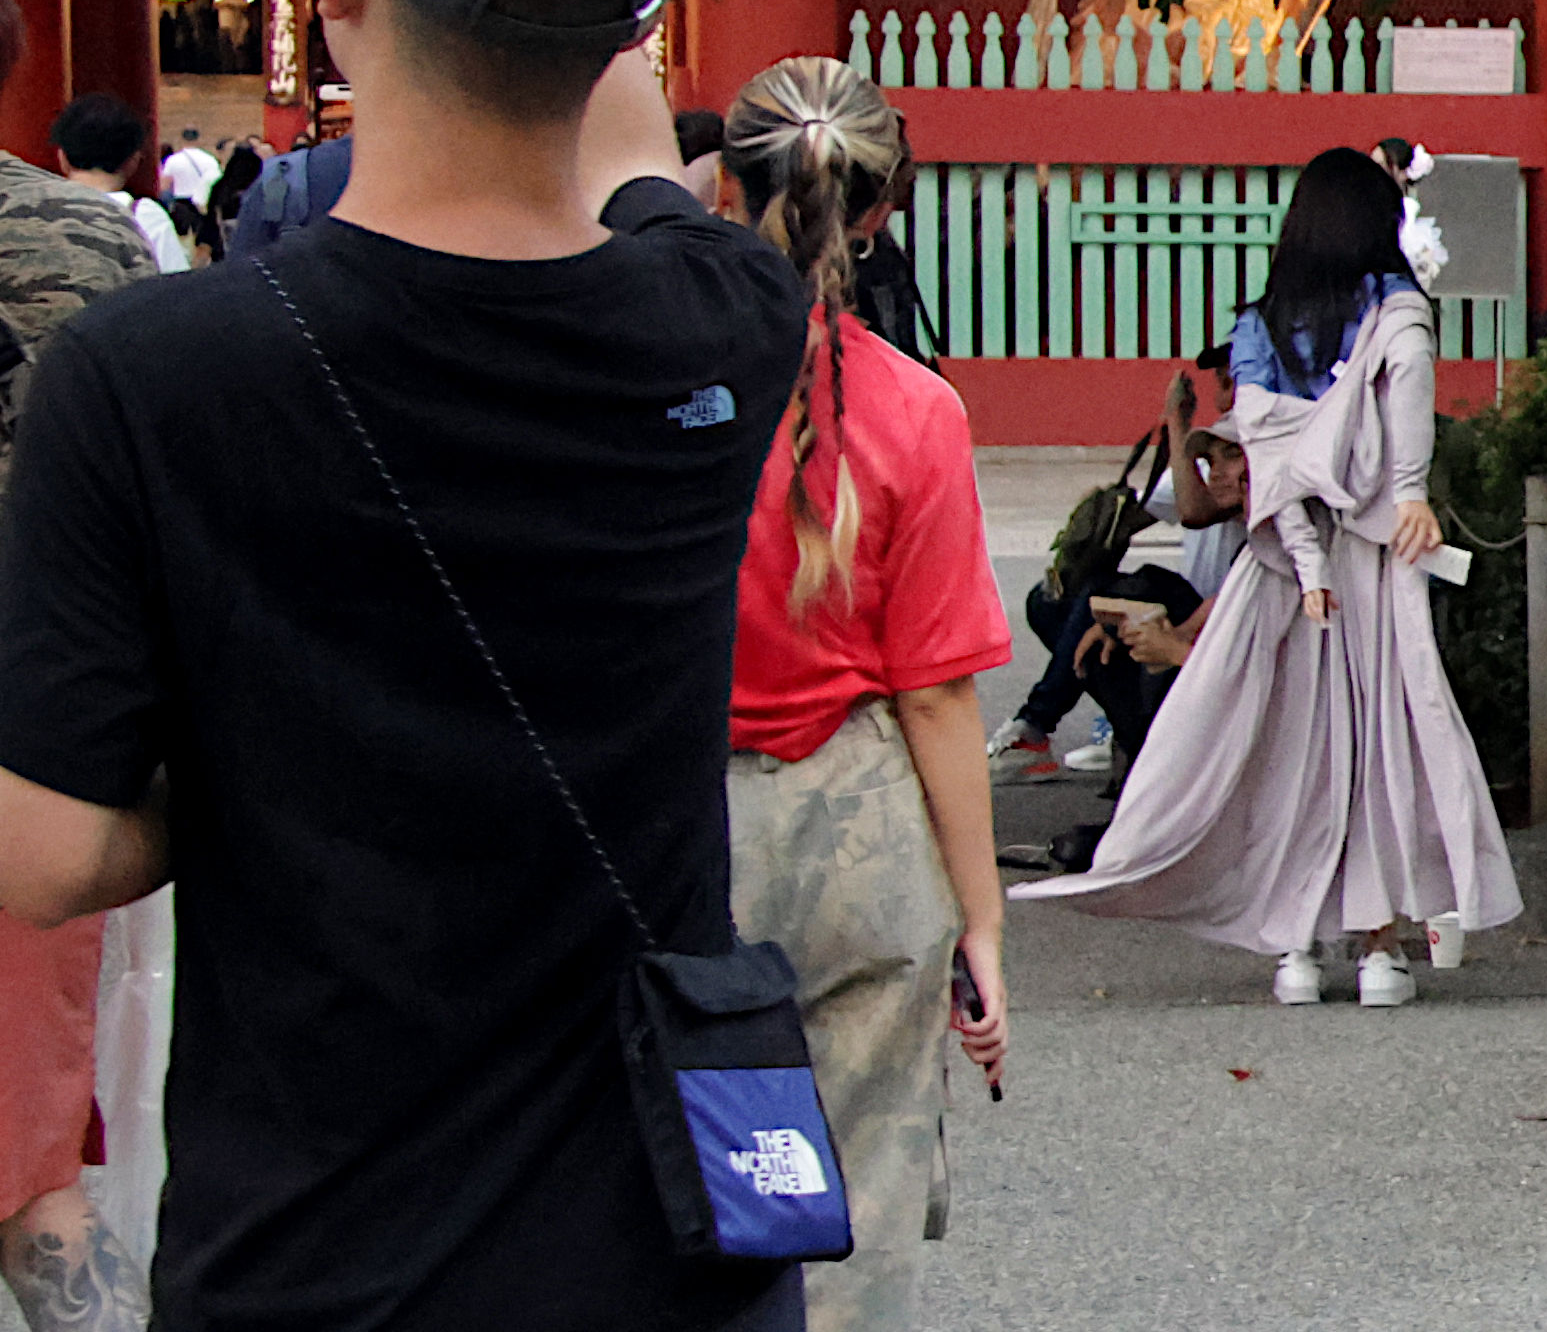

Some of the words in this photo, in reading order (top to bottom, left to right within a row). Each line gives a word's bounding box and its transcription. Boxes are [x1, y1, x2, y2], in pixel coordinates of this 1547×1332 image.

[752, 1129, 792, 1153] THE
[729, 1151, 798, 1175] NORTH
[754, 1173, 800, 1196] FACE
